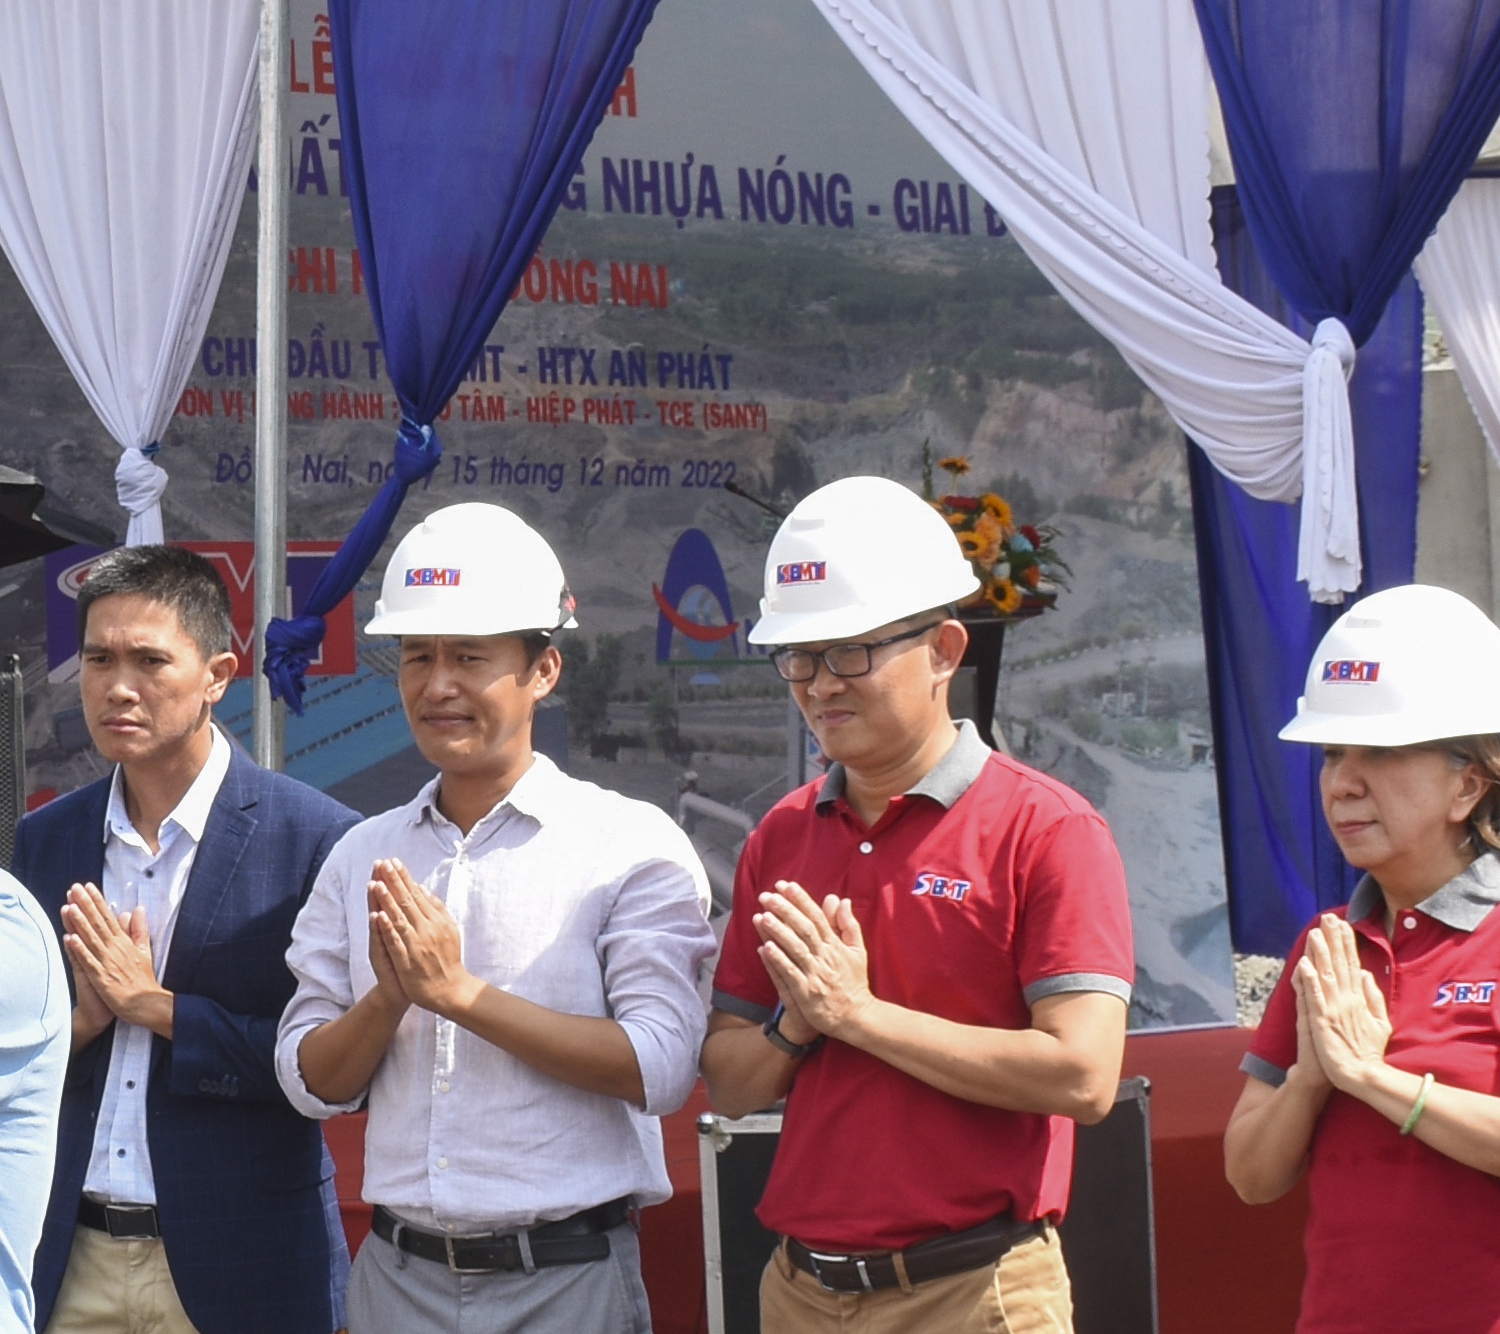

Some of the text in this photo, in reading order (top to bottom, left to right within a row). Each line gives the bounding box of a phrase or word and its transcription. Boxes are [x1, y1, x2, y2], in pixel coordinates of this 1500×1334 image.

[601, 152, 724, 229] NHỰA
[737, 154, 853, 228] NÓNG
[893, 178, 971, 236] GIAI
[510, 243, 598, 306] ỒNG
[610, 260, 669, 308] NAI
[538, 346, 597, 386] HTX
[608, 349, 648, 388] AN
[657, 343, 733, 391] PHÁT
[220, 390, 244, 424] VỊ
[322, 385, 383, 421] HÀNH
[457, 389, 506, 423] TÂM
[527, 391, 578, 430] HIỆP
[583, 393, 637, 425] PHÁT
[656, 400, 695, 427] TCE
[703, 402, 768, 431] (SANY)
[302, 454, 353, 488] Nai,
[453, 455, 478, 484] 15
[490, 457, 564, 492] tháng
[580, 458, 604, 485] 12
[615, 462, 669, 487] năm
[681, 460, 737, 488] 2022
[404, 568, 461, 587] SBMT
[777, 561, 827, 584] SBMT
[1322, 660, 1380, 683] SBMT
[911, 872, 971, 901] SBMT
[1432, 981, 1497, 1007] SBMT
